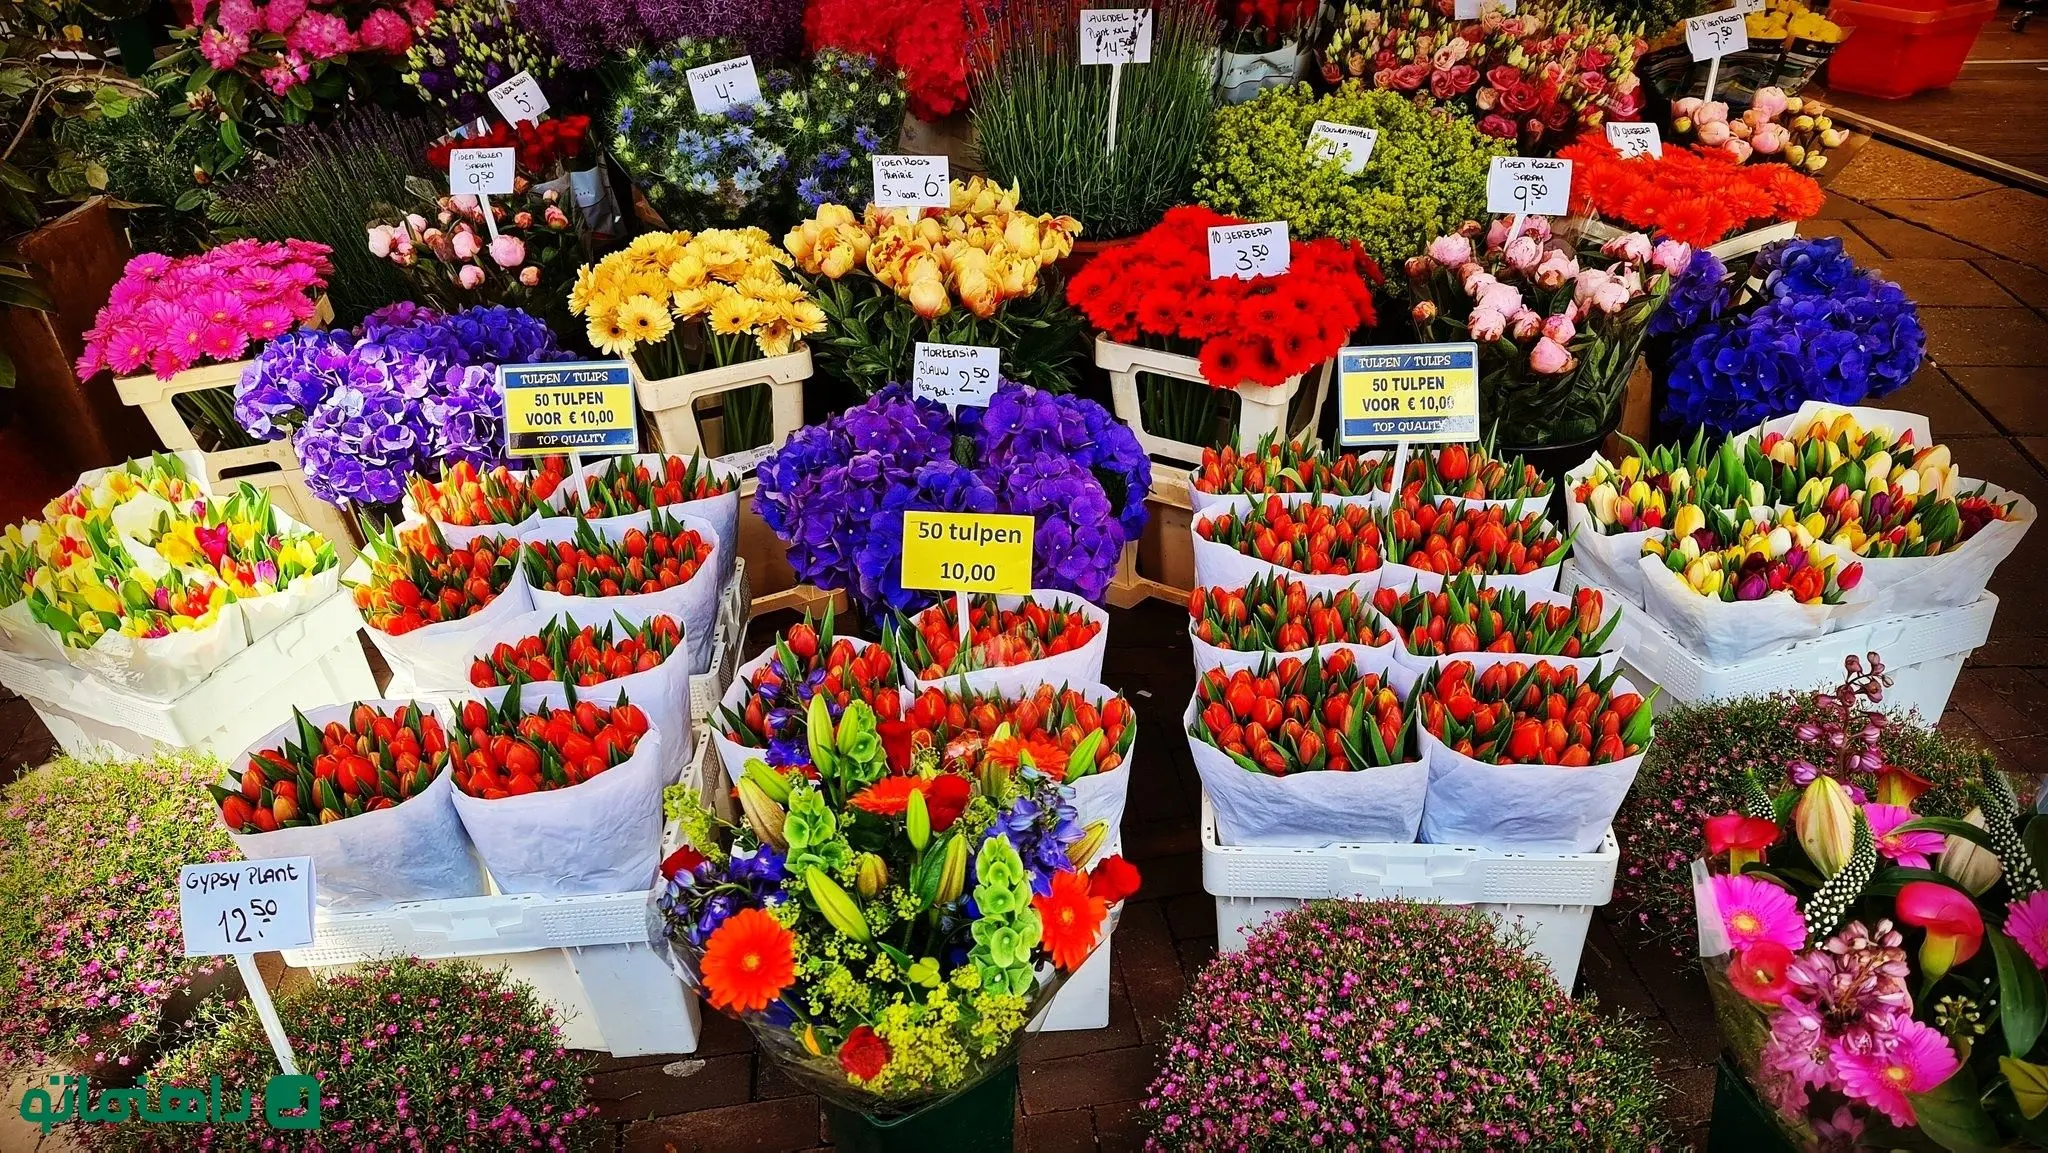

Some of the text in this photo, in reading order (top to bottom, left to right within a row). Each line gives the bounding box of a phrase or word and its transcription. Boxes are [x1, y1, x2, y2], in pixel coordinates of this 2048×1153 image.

[881, 184, 892, 197] 5
[1211, 230, 1222, 244] 10
[1359, 357, 1401, 369] TULPEN
[1413, 355, 1451, 366] TULIPS
[520, 373, 561, 385] TULPEN
[572, 371, 609, 382] TULIPS
[1372, 376, 1445, 392] 50 TULPEN
[534, 391, 604, 407] 50 TULPEN
[1362, 395, 1454, 412] VOOR € 10,00
[525, 409, 614, 426] VOOR € 10,00
[1372, 419, 1446, 432] TOP QUALITY
[536, 433, 607, 445] TOP QUALITY
[918, 521, 1022, 547] 50 tulpen
[940, 562, 996, 583] 10,00
